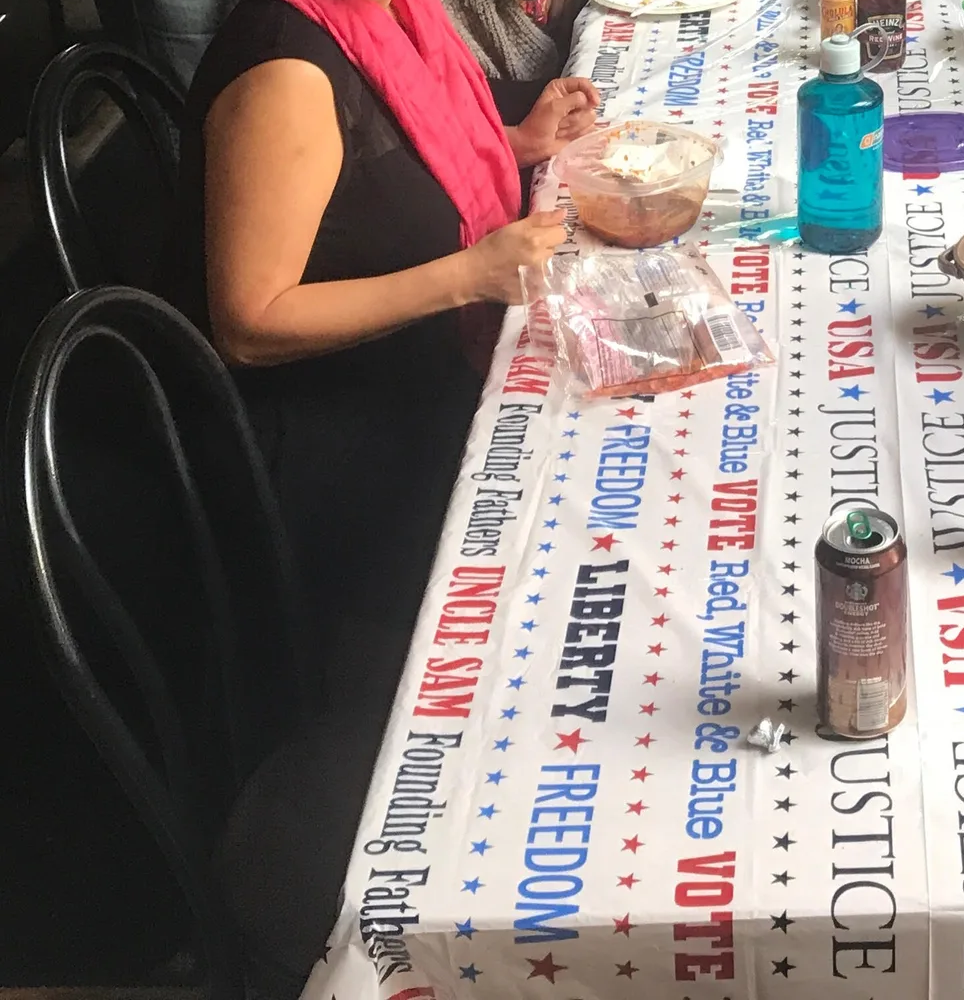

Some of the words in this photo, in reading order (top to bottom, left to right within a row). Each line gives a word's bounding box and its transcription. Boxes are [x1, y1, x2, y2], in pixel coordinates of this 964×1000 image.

[897, 48, 932, 111] USTICE
[731, 244, 771, 295] VOTE
[905, 201, 964, 302] JUSTICE
[826, 314, 875, 382] USA
[912, 322, 964, 384] USA
[722, 404, 759, 421] &
[725, 372, 761, 400] ite
[471, 404, 543, 483] Founding
[586, 424, 651, 531] FREEDOM
[719, 424, 758, 474] Blue
[460, 482, 522, 557] Fathers
[707, 479, 758, 552] VOTE
[697, 560, 750, 620] Red,
[845, 556, 870, 566] MOCHA
[433, 565, 506, 648] UNCLE
[551, 560, 630, 723] LIBERTY
[412, 656, 484, 719] SAM
[695, 620, 745, 717] White
[695, 723, 738, 754] &
[364, 731, 463, 855] Founding
[685, 758, 737, 840] Blue
[513, 764, 600, 945] FREEDOM
[674, 851, 736, 982] VOTE
